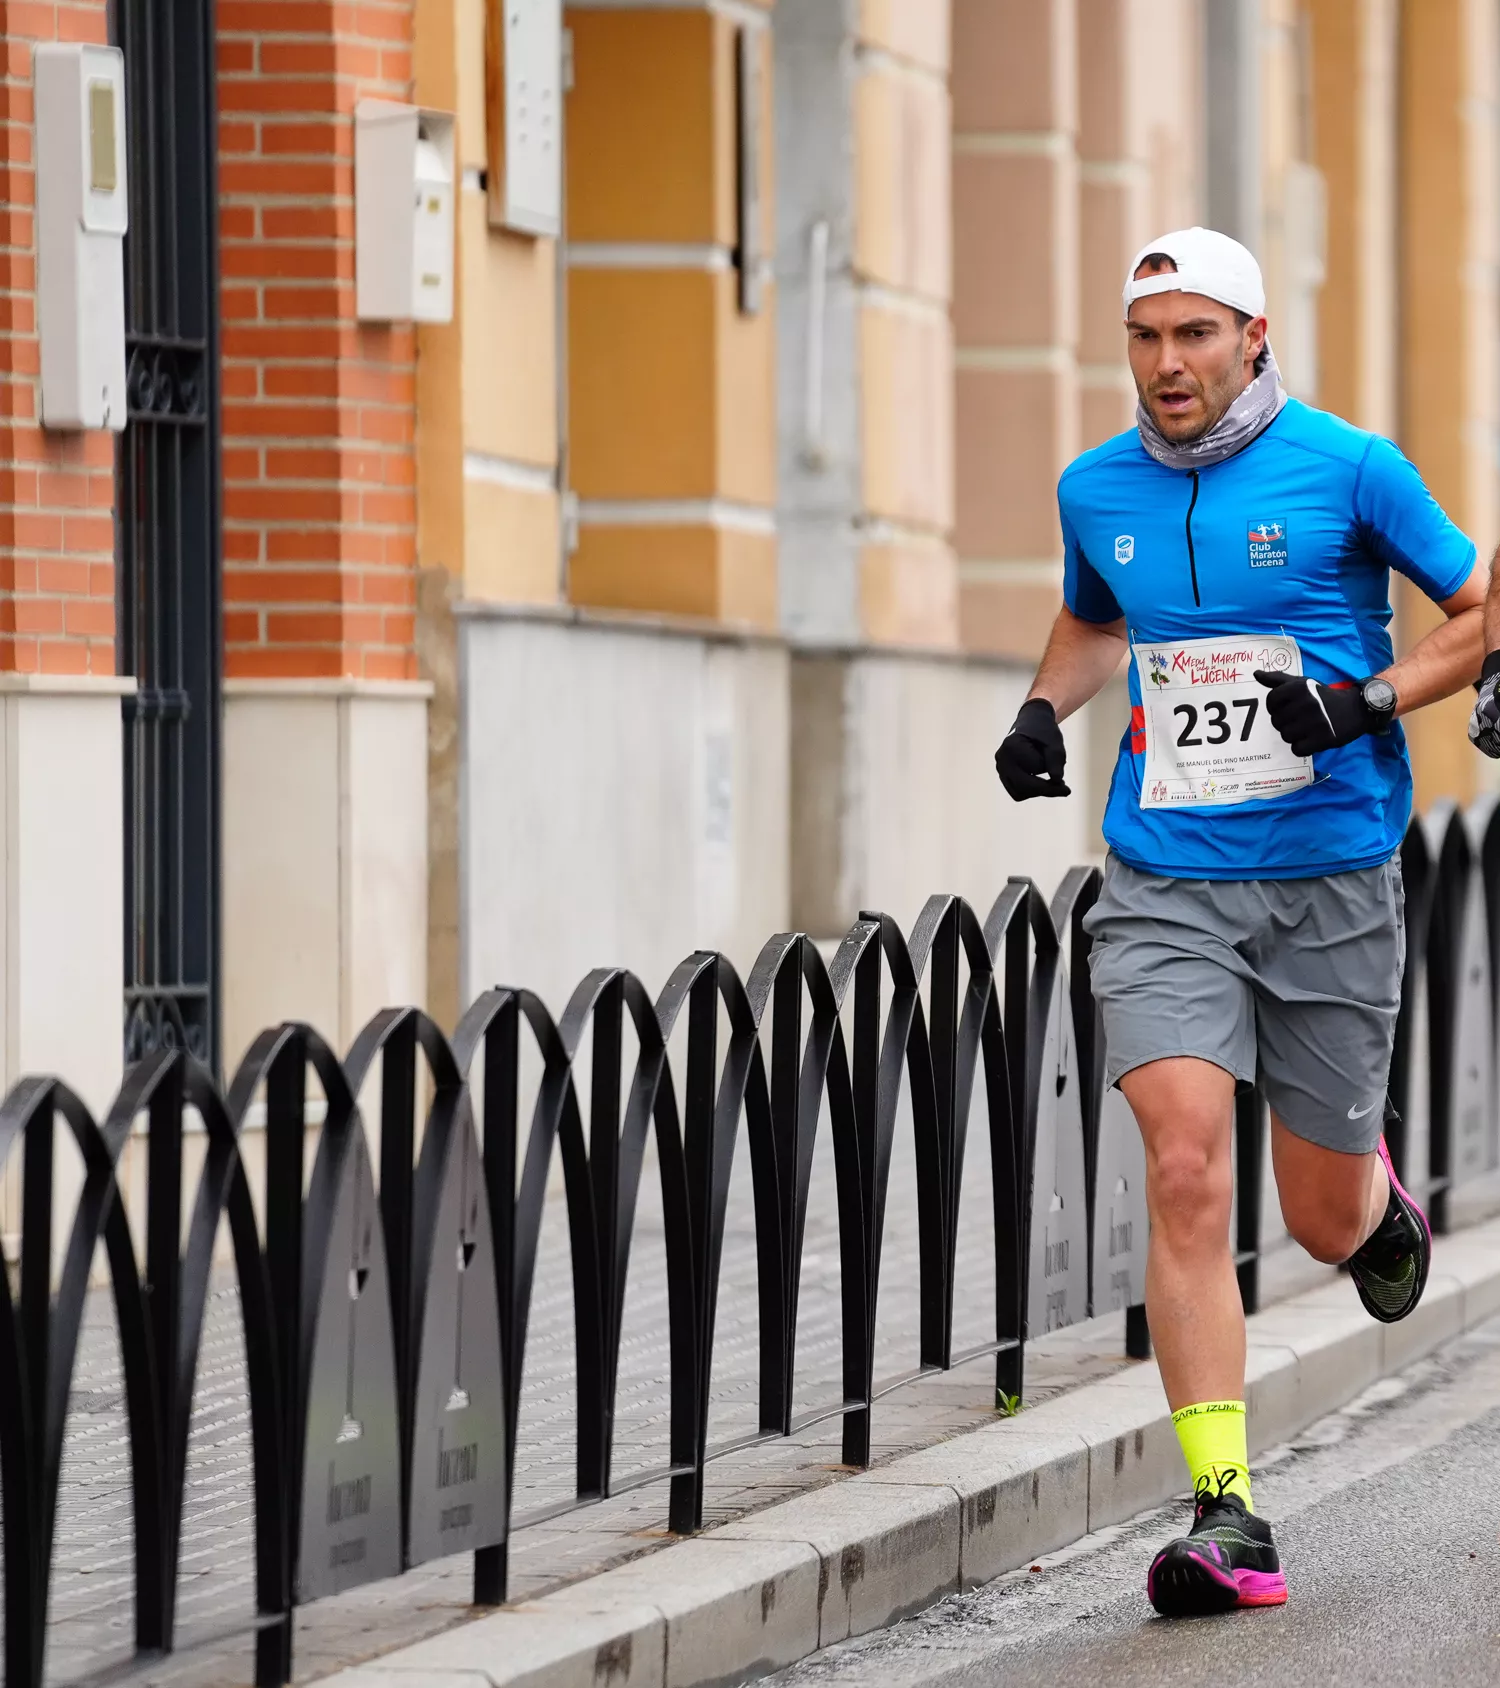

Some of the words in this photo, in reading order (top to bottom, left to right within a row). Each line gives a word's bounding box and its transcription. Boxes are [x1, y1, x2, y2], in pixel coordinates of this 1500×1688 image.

[1249, 542, 1271, 552] Club
[1117, 550, 1130, 560] OVAL
[1250, 549, 1287, 560] Maratón
[1250, 558, 1284, 568] Lucena
[1191, 667, 1244, 685] LUCENA
[1173, 697, 1259, 748] 237
[1239, 754, 1272, 763] MARTINEZ
[1207, 767, 1236, 775] S-Hombre
